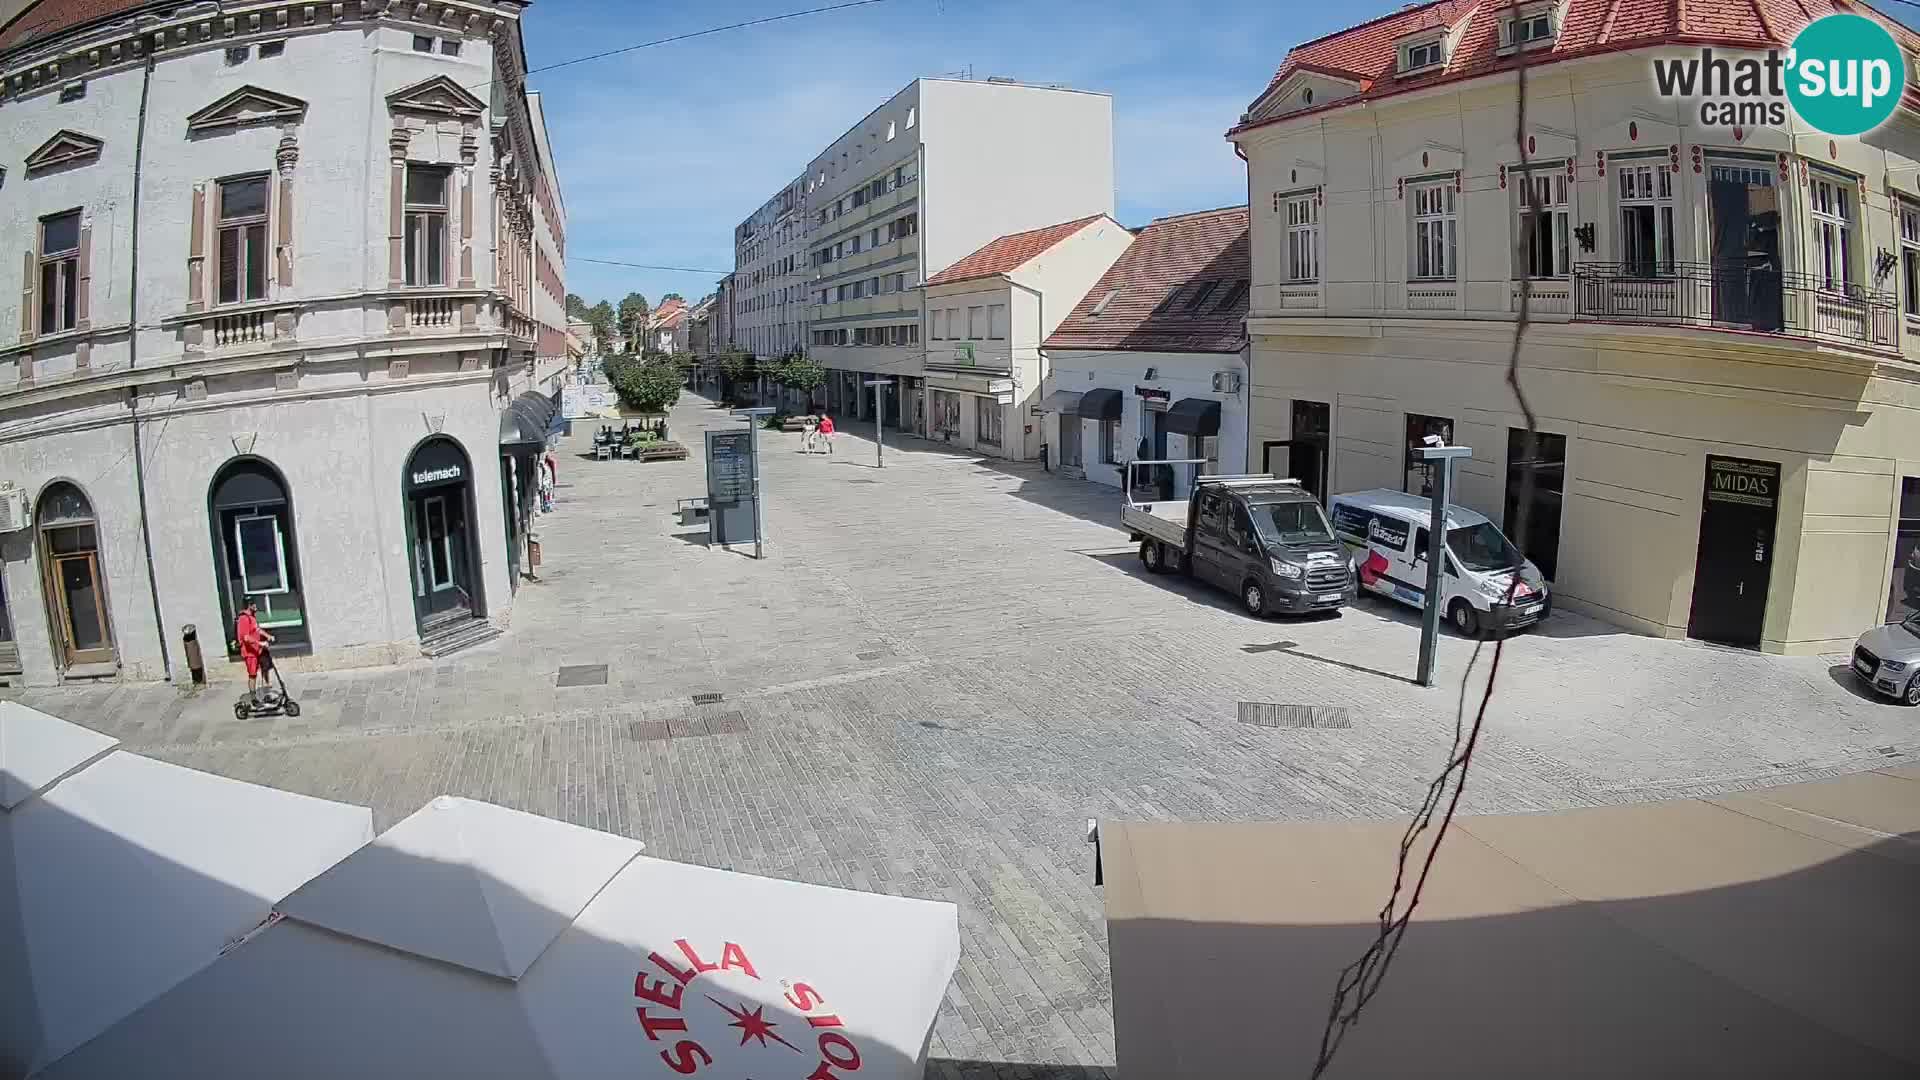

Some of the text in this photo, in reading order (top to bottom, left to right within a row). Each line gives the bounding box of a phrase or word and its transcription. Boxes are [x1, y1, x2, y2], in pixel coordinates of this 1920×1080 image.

[413, 465, 461, 484] telemach
[1715, 472, 1769, 494] MIDAS
[635, 939, 761, 1074] STELLA
